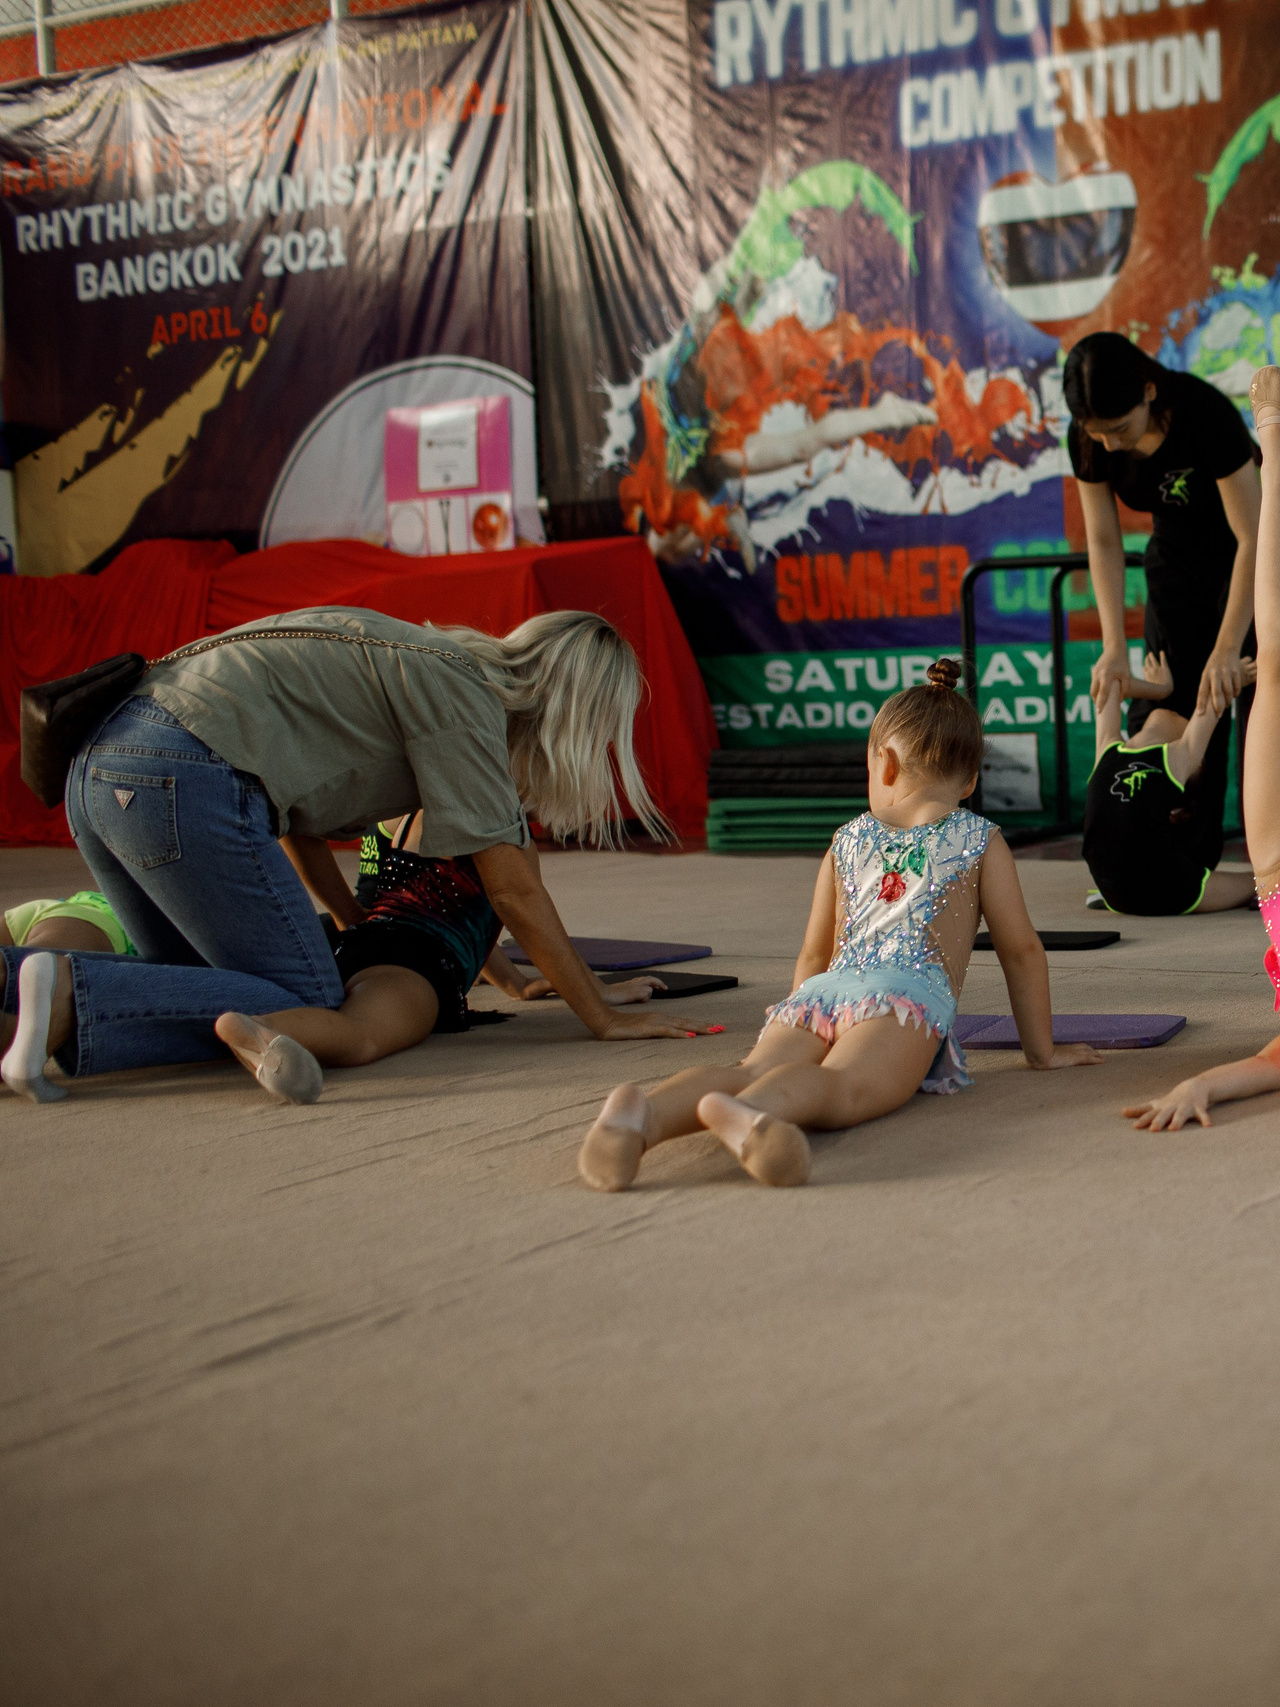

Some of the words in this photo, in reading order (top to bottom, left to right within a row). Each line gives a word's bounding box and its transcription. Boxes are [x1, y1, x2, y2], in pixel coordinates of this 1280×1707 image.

[714, 0, 979, 88] RYTHMIC
[900, 29, 1222, 149] COMPETITION
[2, 148, 93, 197] RAND
[15, 192, 196, 254] RHYTHMIC
[204, 150, 452, 227] GYMNASTICS
[75, 241, 243, 301] BANGKOK
[261, 226, 347, 277] 2021
[150, 305, 242, 346] APRIL
[250, 302, 268, 335] 6
[775, 546, 970, 624] SUMMER
